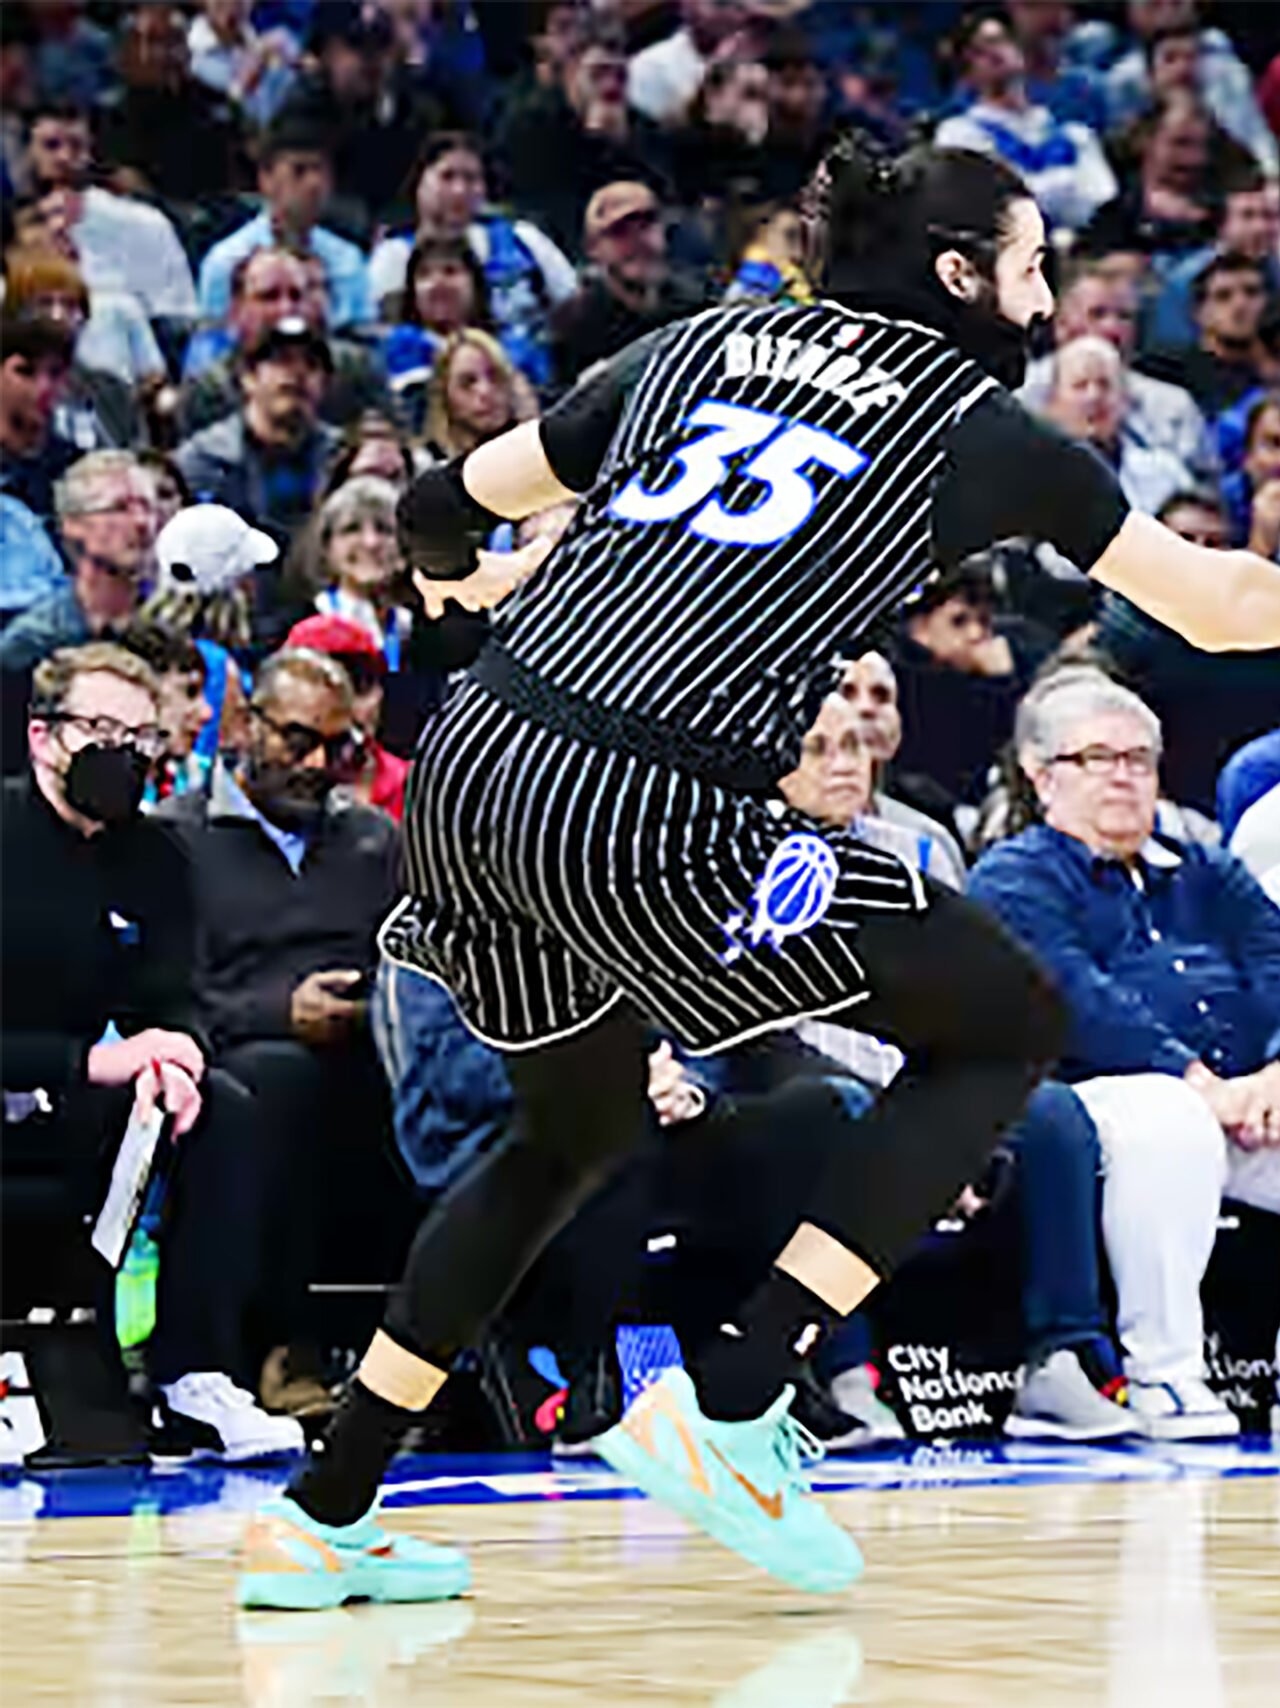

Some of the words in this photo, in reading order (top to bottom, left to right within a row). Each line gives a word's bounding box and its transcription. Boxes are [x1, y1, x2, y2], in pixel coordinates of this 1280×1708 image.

[608, 397, 871, 550] 35
[887, 1343, 949, 1376] City
[908, 1399, 994, 1433] Bank
